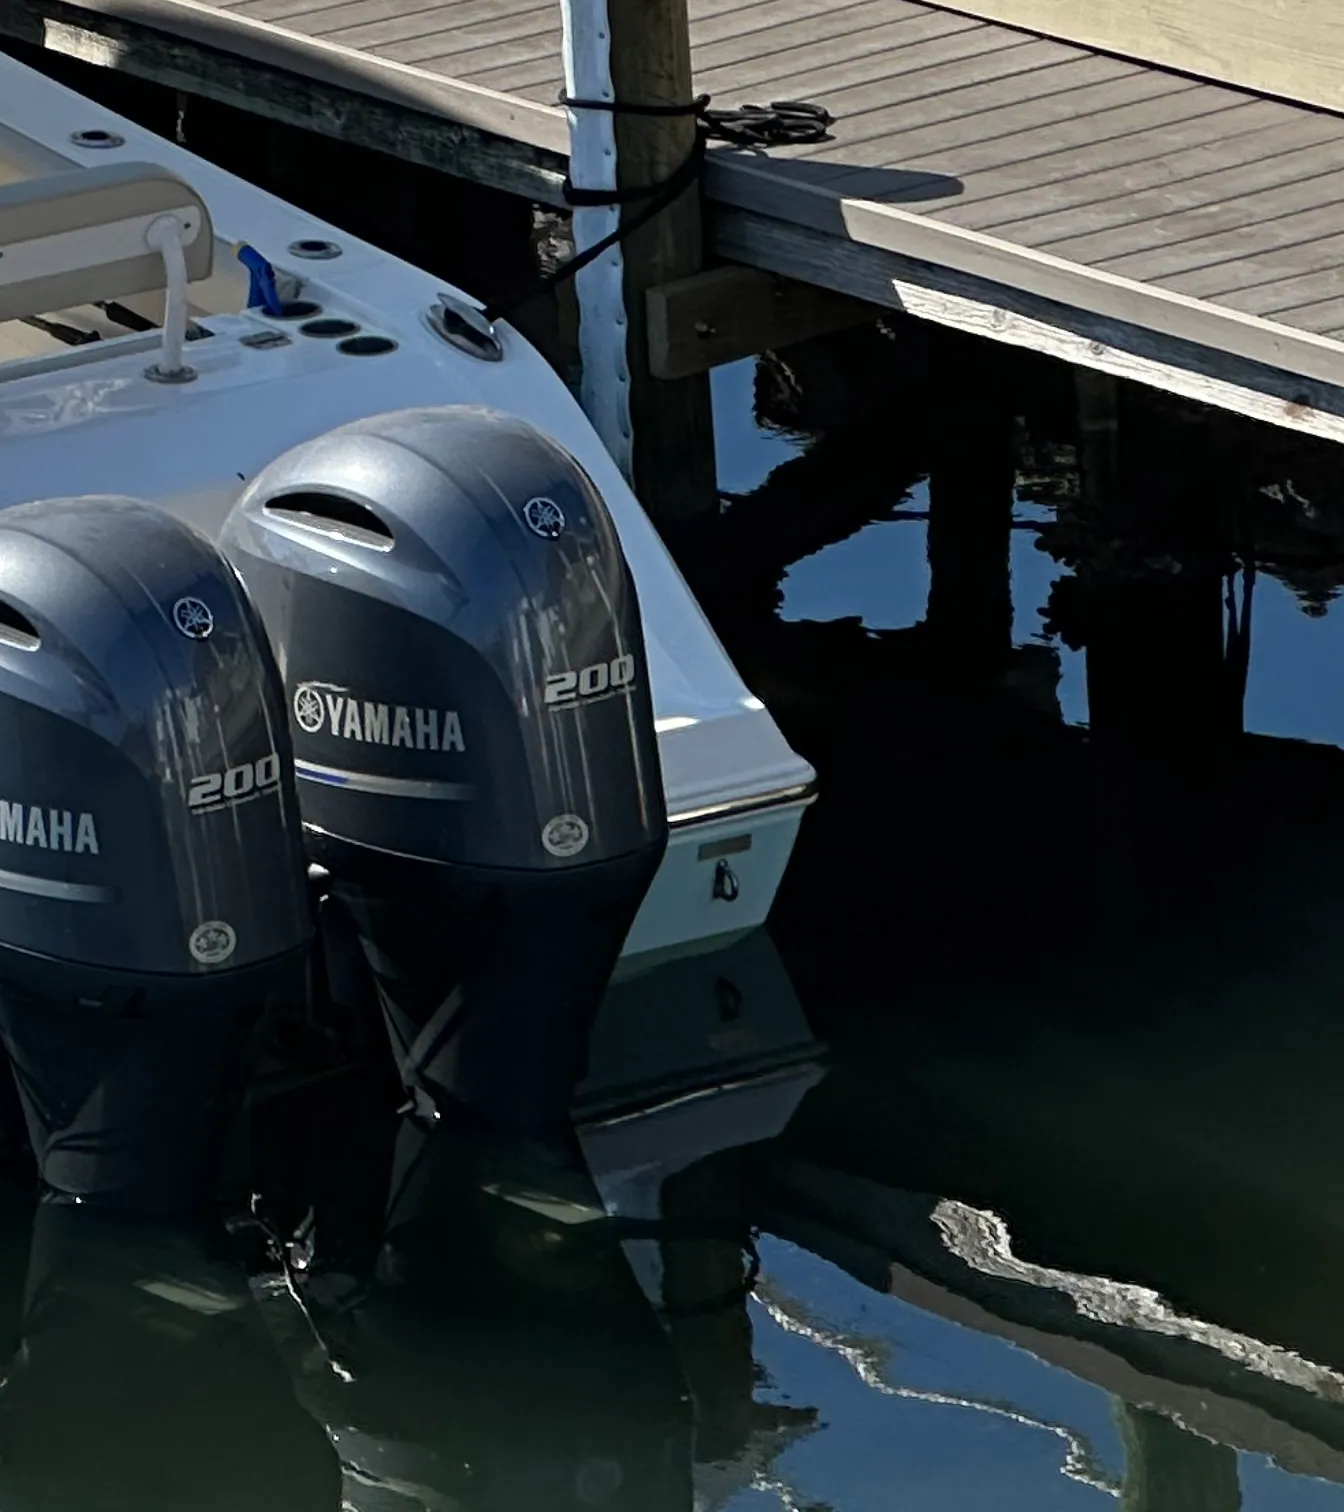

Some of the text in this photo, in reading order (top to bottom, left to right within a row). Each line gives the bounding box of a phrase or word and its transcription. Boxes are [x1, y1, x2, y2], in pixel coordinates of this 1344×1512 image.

[544, 653, 635, 704] 200
[326, 694, 466, 753] YAMAHA
[188, 752, 281, 807] 200
